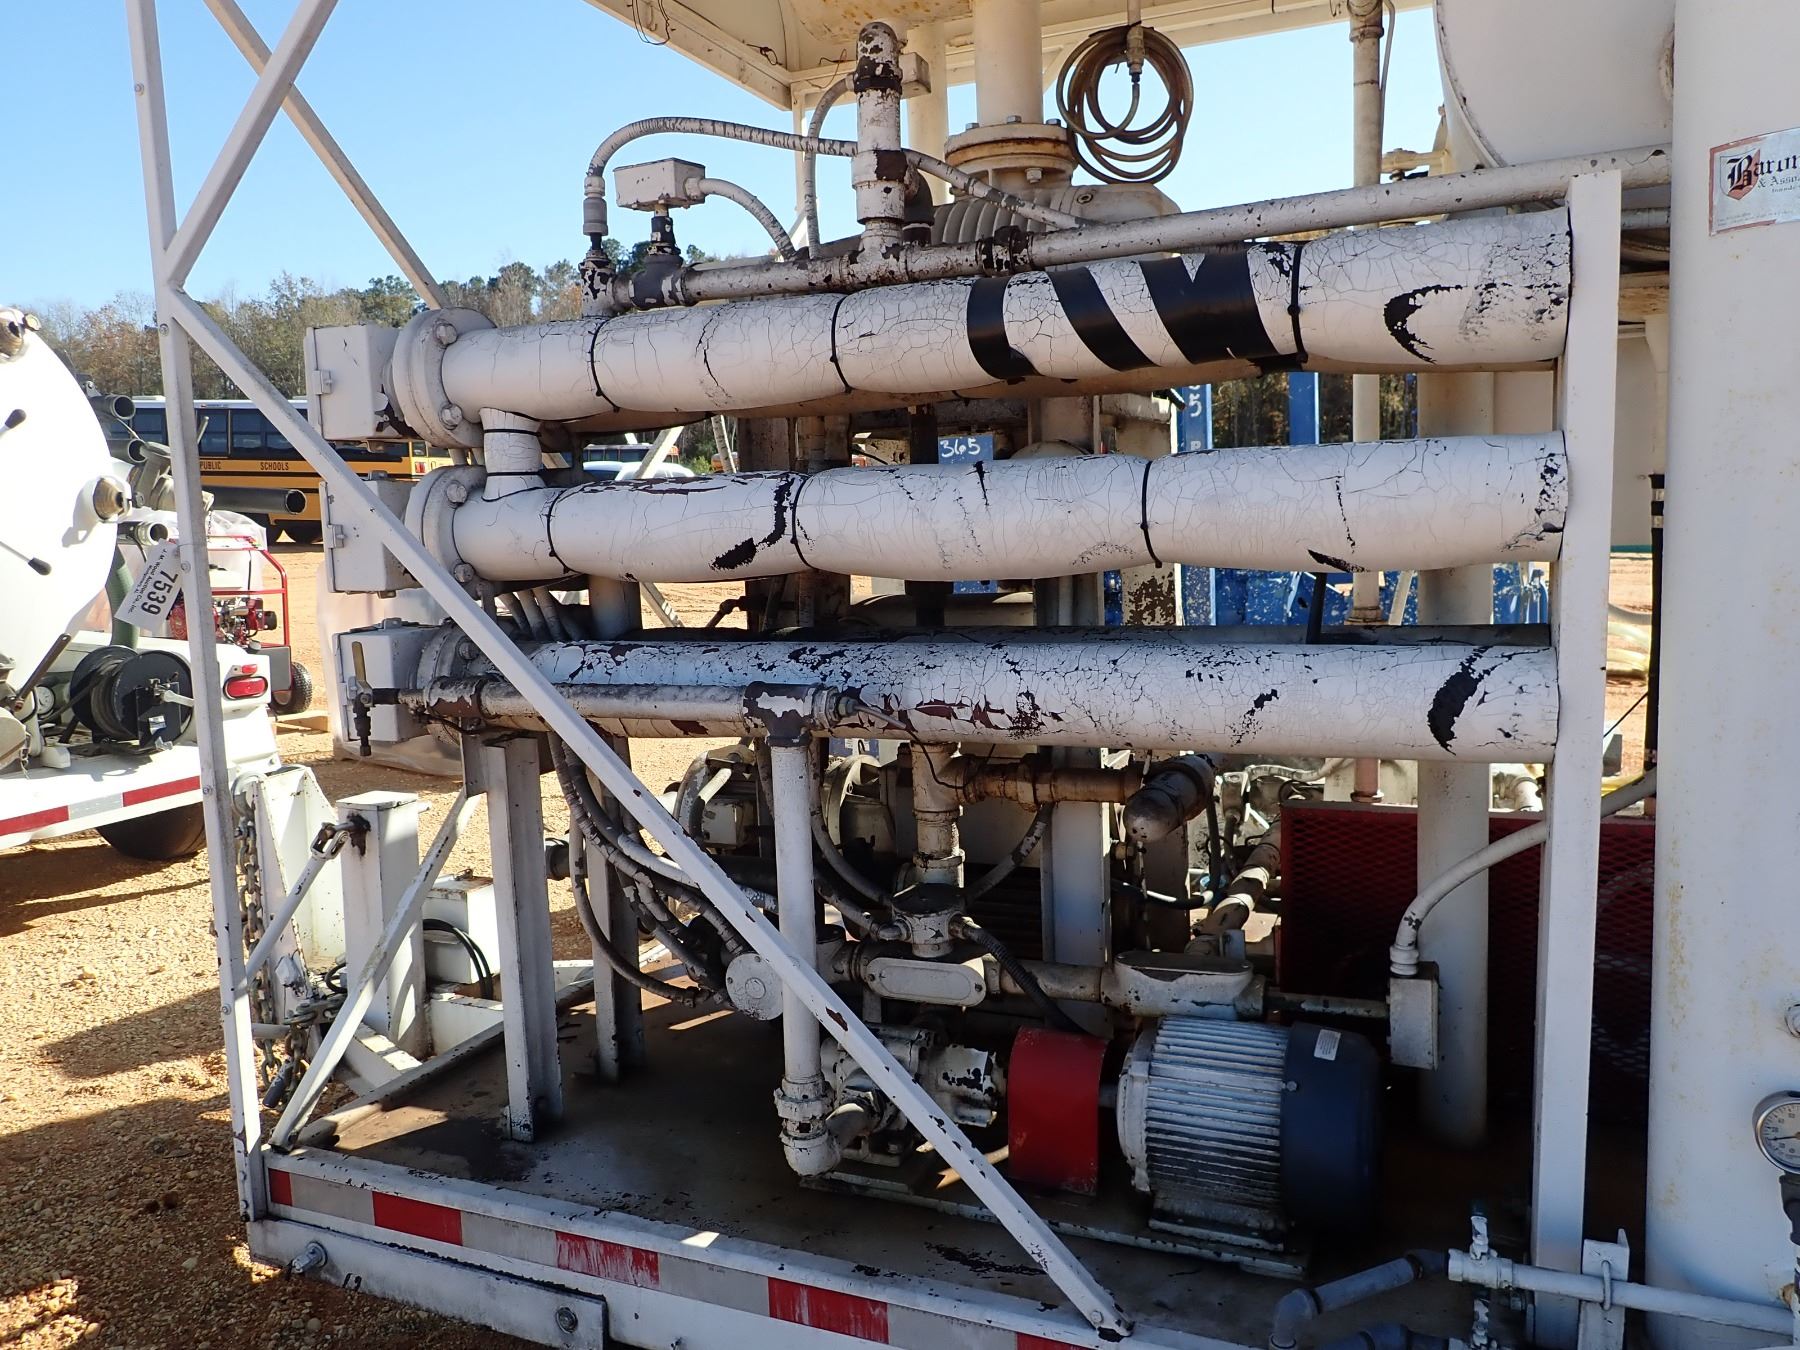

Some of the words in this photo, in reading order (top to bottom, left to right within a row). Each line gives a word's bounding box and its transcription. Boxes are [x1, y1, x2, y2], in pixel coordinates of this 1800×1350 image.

[940, 438, 981, 458] 365
[200, 461, 222, 470] PUBLIC
[260, 461, 289, 471] SCHOOLS
[150, 561, 160, 576] Wood
[139, 575, 153, 594] Auction
[141, 570, 179, 616] 7539
